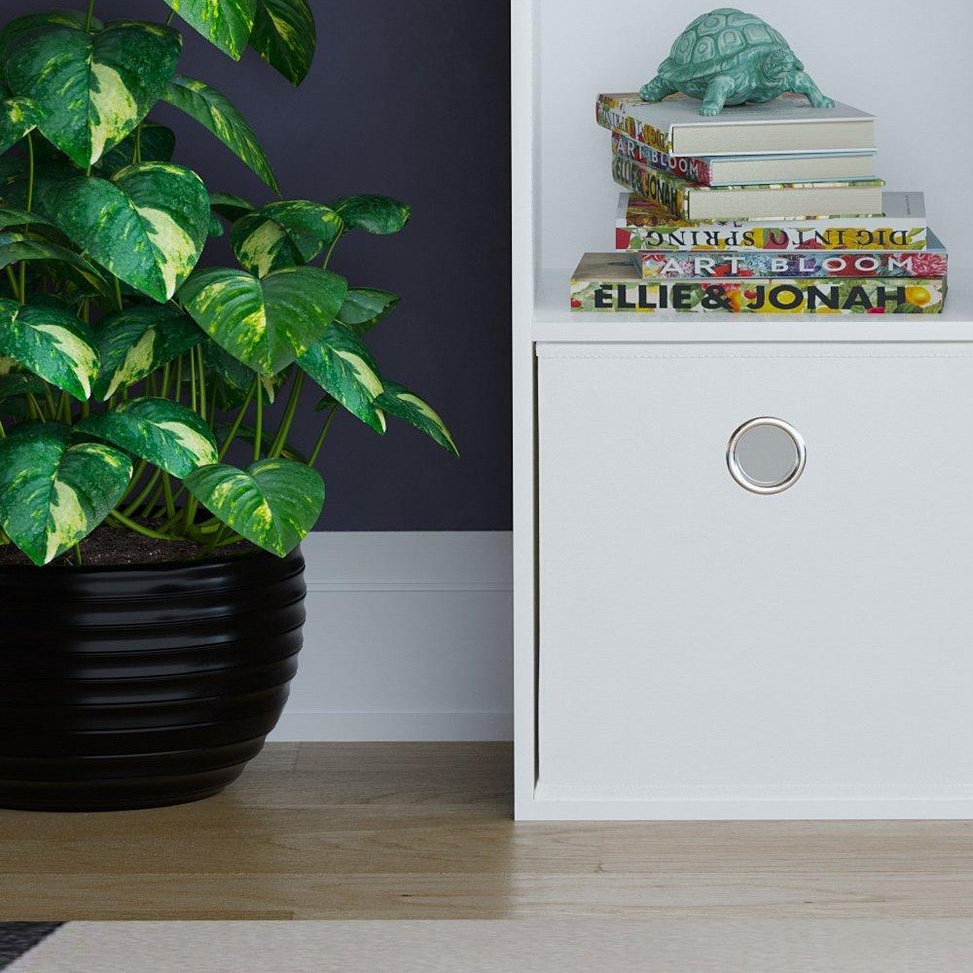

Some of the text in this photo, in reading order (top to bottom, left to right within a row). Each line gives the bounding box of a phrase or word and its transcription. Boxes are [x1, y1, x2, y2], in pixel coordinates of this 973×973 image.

[616, 140, 699, 176] ART BLOOM
[646, 229, 909, 247] DIG INTO SPRING
[659, 257, 917, 275] ART BLOOM
[594, 284, 692, 310] ELLIE
[746, 284, 907, 311] JONAH
